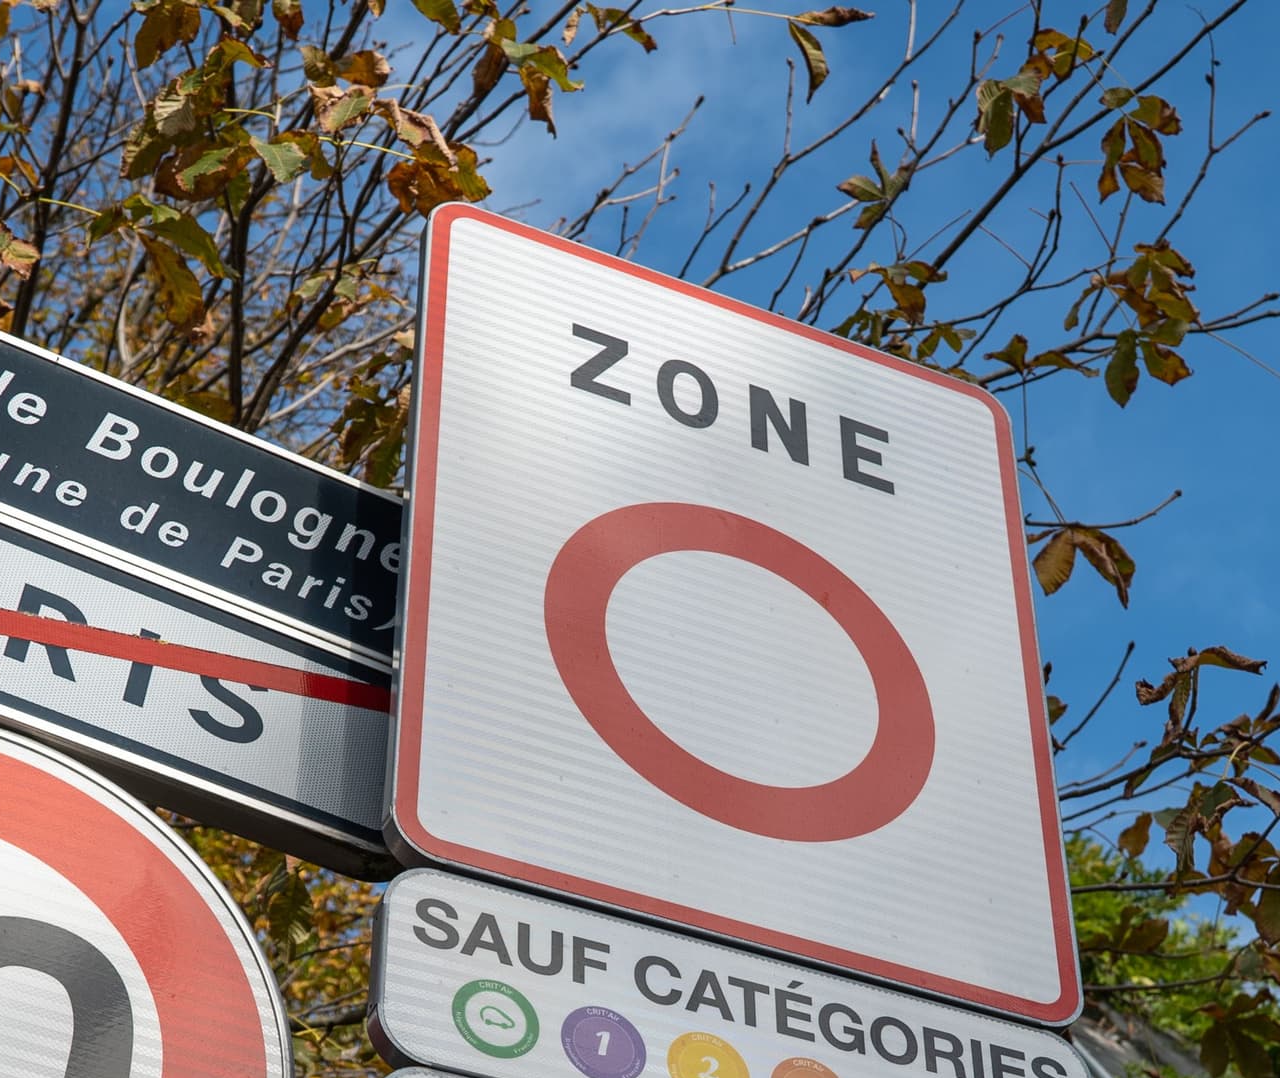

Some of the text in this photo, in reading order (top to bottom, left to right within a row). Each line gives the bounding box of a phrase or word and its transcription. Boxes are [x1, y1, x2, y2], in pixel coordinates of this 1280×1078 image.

[570, 322, 895, 496] ZONE
[120, 502, 190, 548] de
[412, 897, 611, 986] SAUF
[595, 1031, 611, 1056] 1
